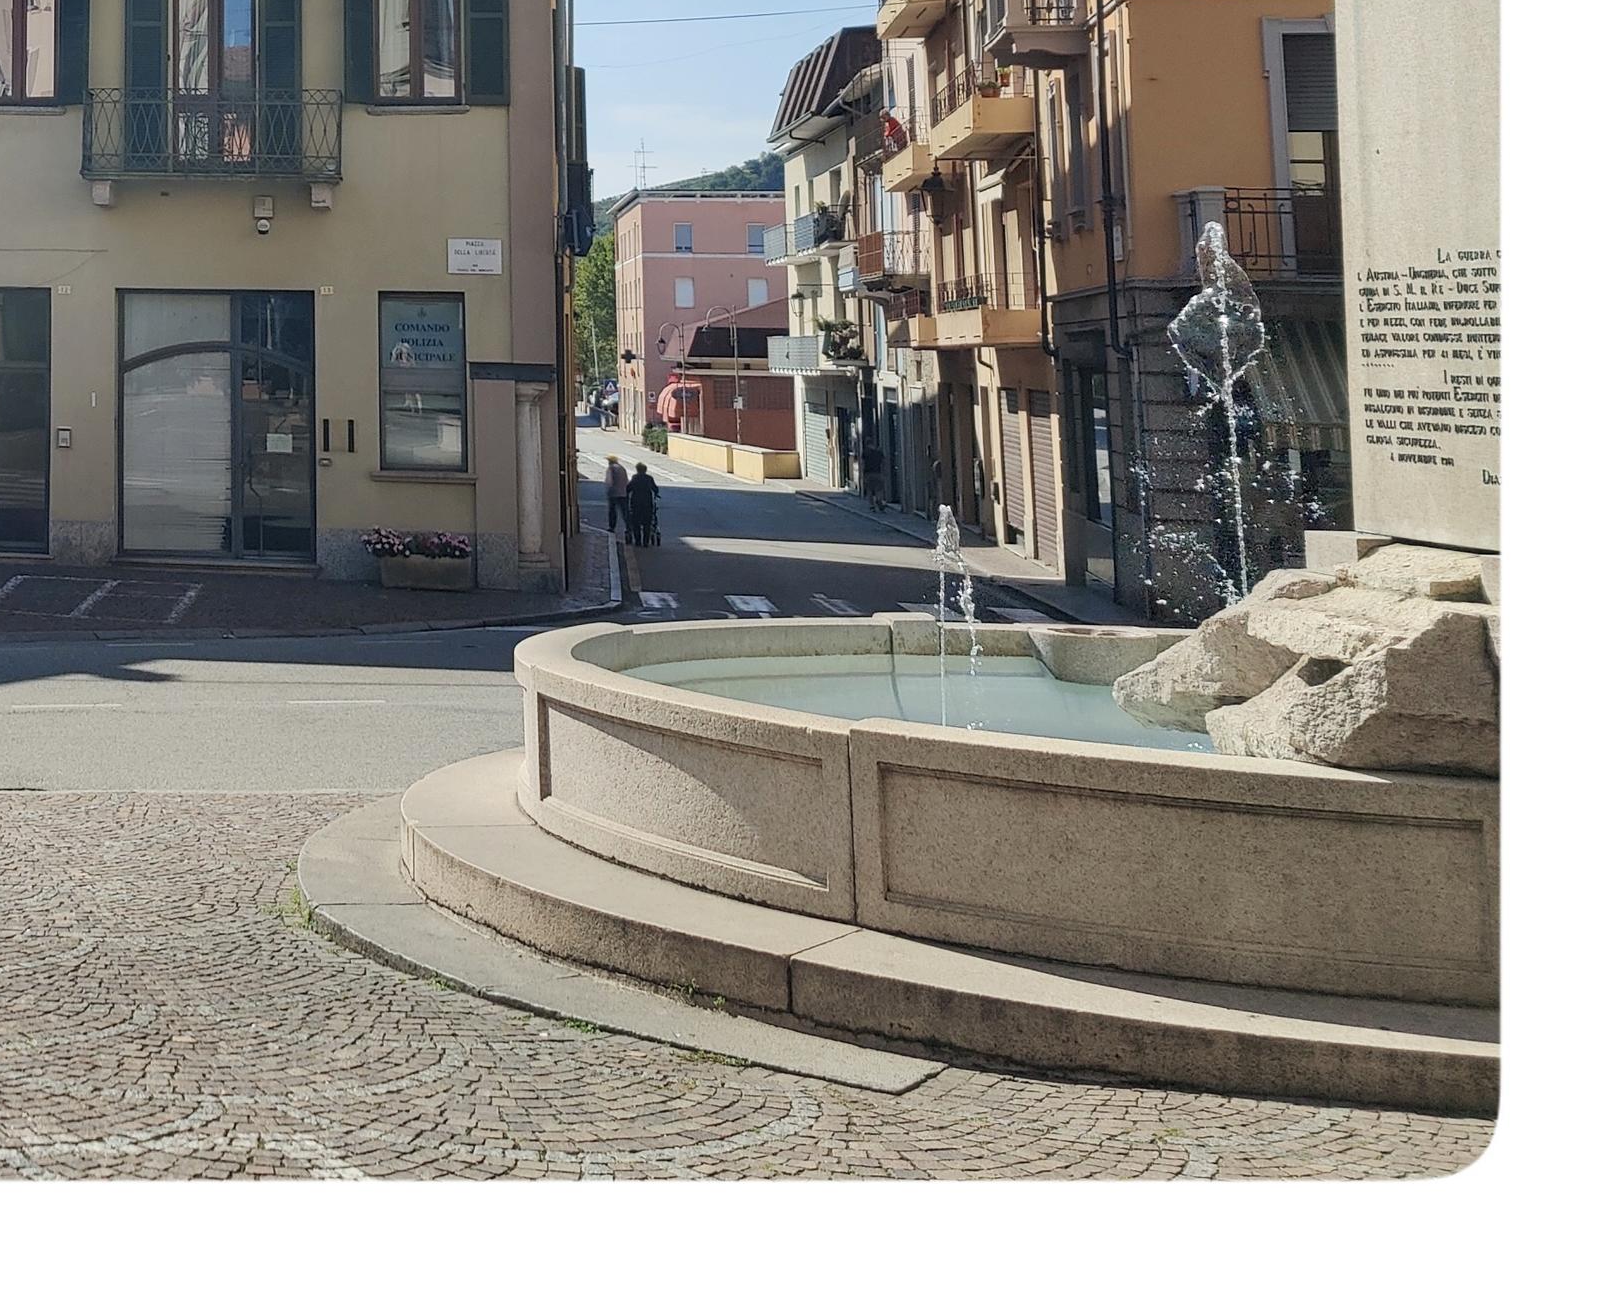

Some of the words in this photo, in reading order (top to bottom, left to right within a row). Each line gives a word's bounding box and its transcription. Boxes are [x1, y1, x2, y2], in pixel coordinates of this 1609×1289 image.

[394, 322, 450, 332] COMANDO
[400, 337, 444, 347] POLIZIA
[389, 352, 457, 362] MUNICIPALE
